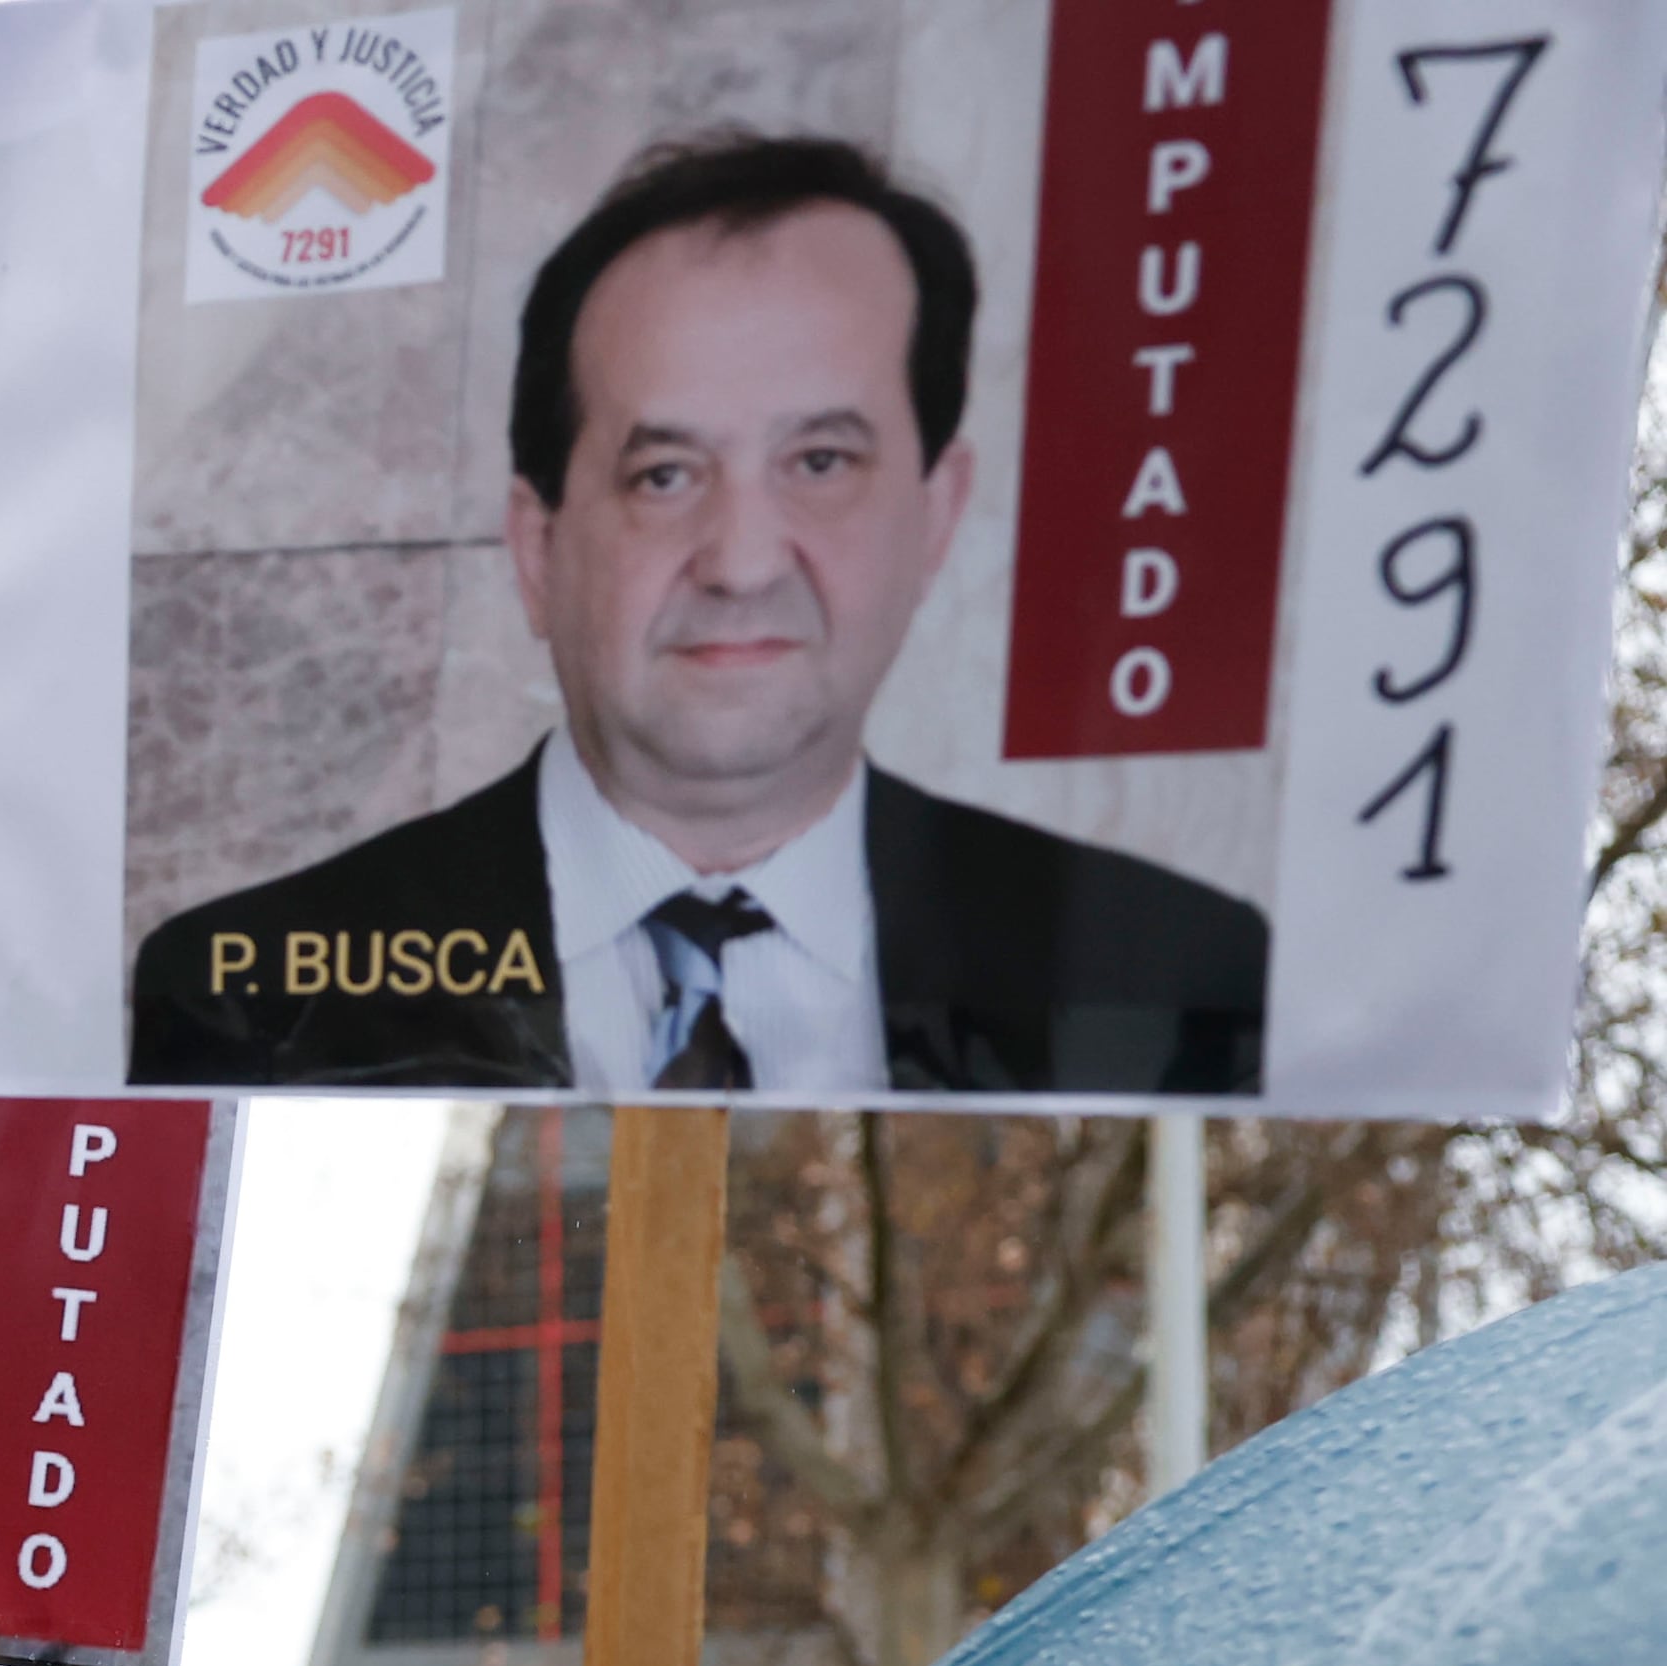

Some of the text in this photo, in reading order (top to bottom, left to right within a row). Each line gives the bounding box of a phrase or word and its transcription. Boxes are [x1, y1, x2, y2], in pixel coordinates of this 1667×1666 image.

[196, 27, 445, 154] VERDAD Y JUSTICIA
[281, 227, 350, 263] 7291
[1111, 0, 1228, 718] MPUTADO
[1358, 33, 1553, 884] 7291
[210, 927, 544, 996] P. BUSCA
[15, 1124, 117, 1593] PUTADO
